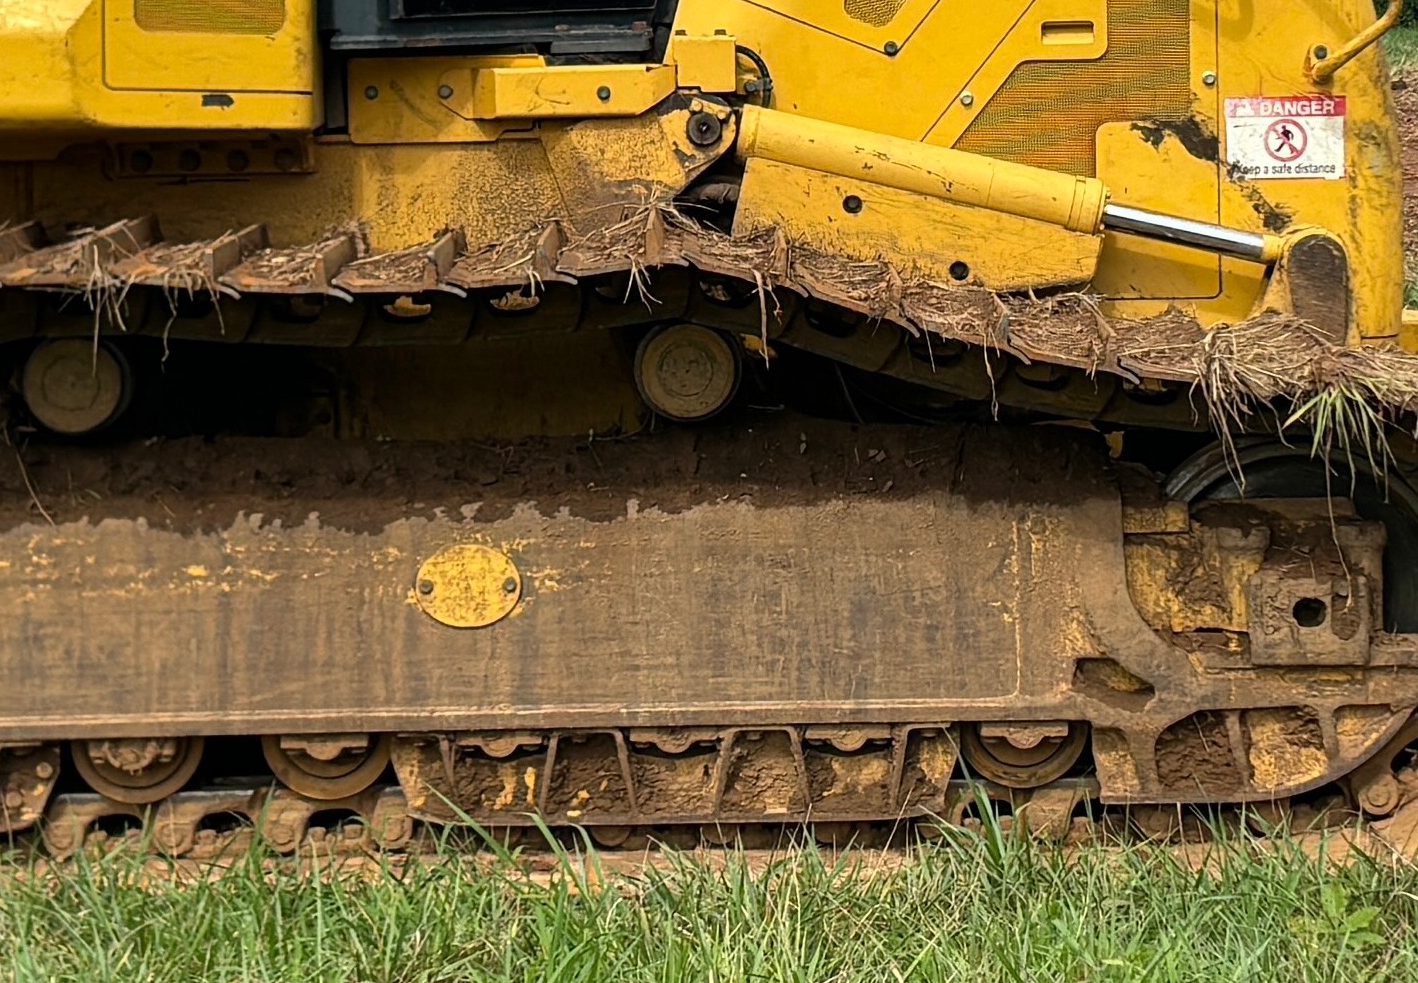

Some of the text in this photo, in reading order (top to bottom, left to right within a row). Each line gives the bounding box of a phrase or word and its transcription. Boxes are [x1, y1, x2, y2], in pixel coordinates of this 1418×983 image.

[1259, 101, 1335, 116] DANGER
[1264, 165, 1269, 173] a
[1272, 163, 1292, 174] safe
[1295, 163, 1336, 174] distance
